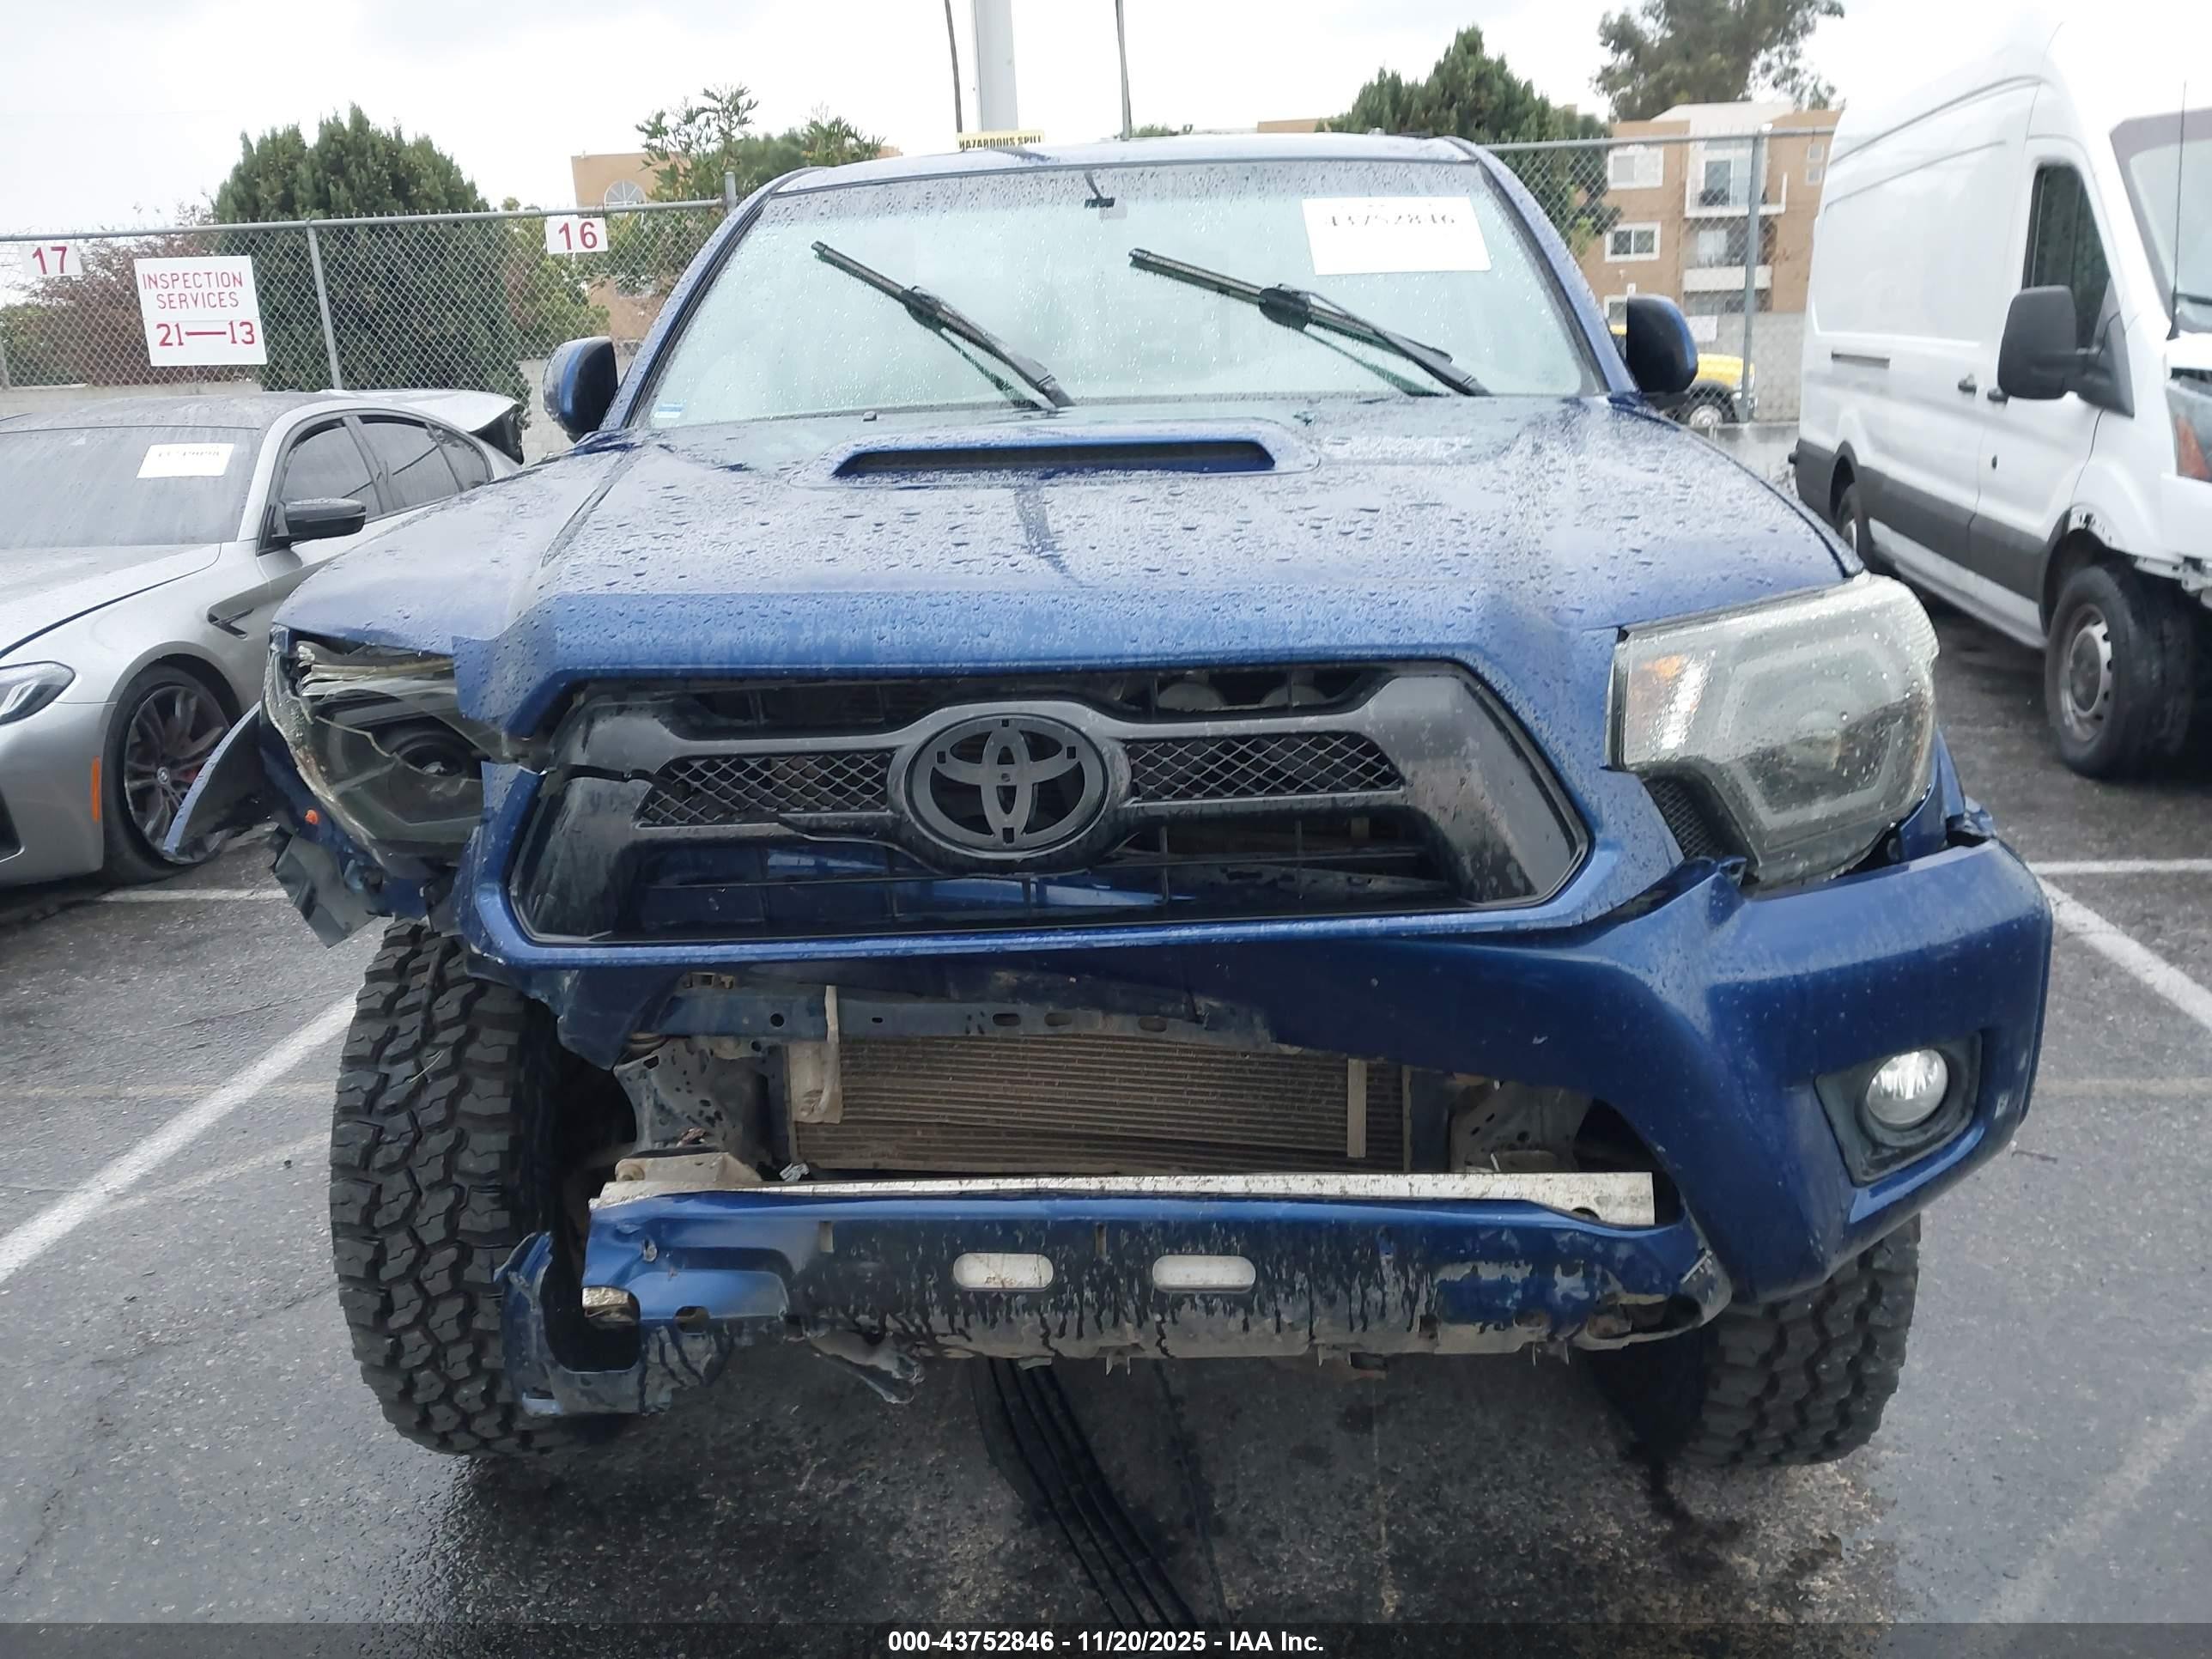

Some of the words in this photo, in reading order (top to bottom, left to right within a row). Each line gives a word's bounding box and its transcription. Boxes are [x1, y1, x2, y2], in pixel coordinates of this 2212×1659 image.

[958, 137, 1016, 151] HAZARDOUS
[558, 221, 598, 251] 16
[32, 246, 67, 275] 17
[143, 271, 243, 290] INSPECTION
[156, 291, 240, 310] SERVICES
